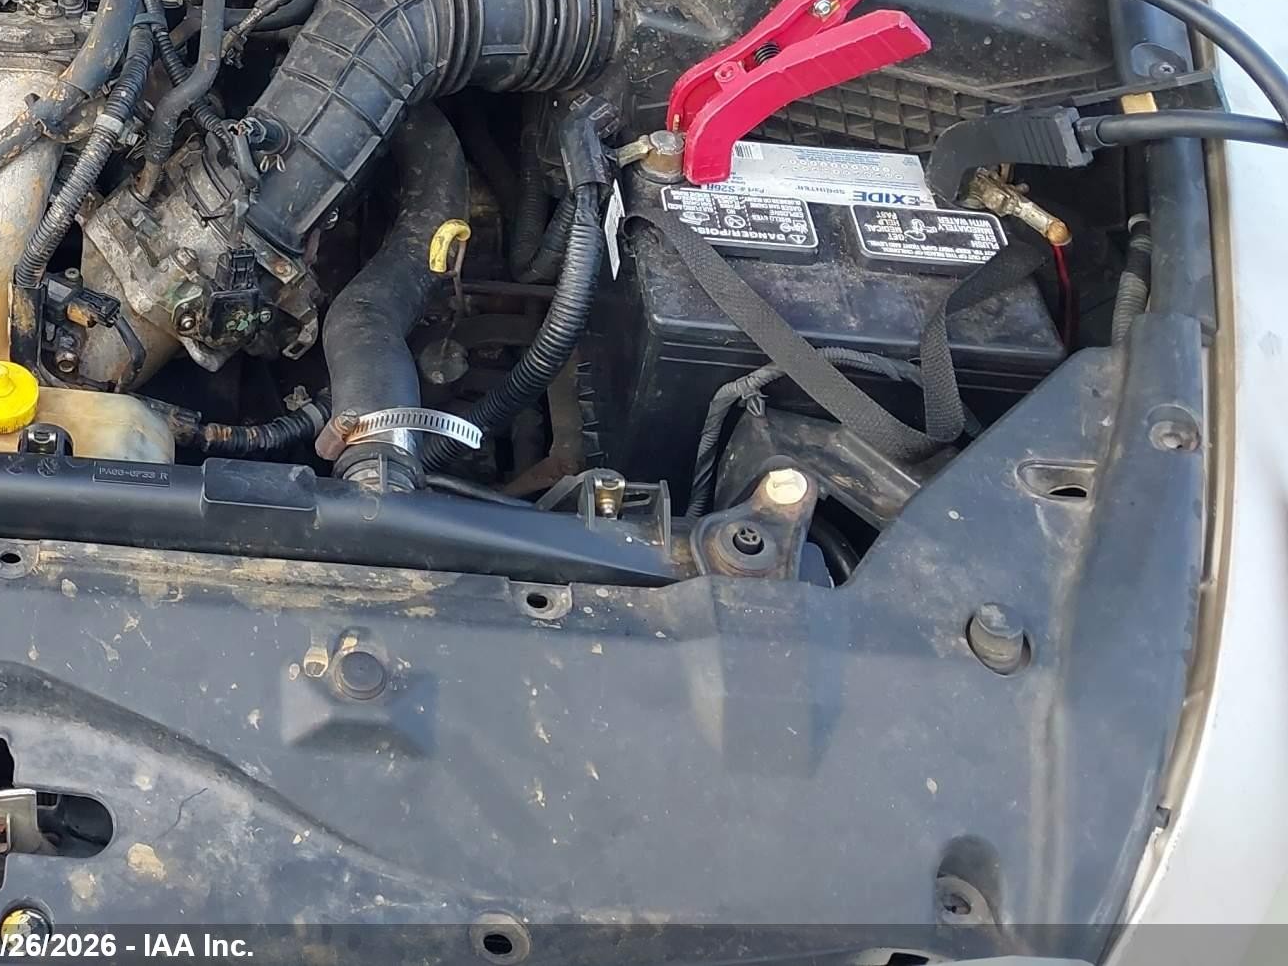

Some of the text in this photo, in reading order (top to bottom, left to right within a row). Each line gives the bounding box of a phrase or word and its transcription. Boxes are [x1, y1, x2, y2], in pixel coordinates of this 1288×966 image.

[852, 190, 920, 206] EXIDE
[877, 218, 900, 226] HELP
[936, 216, 968, 226] WATER
[864, 223, 903, 234] MEDICAL
[937, 223, 995, 234] IMMEDIATELY
[887, 232, 905, 241] GET
